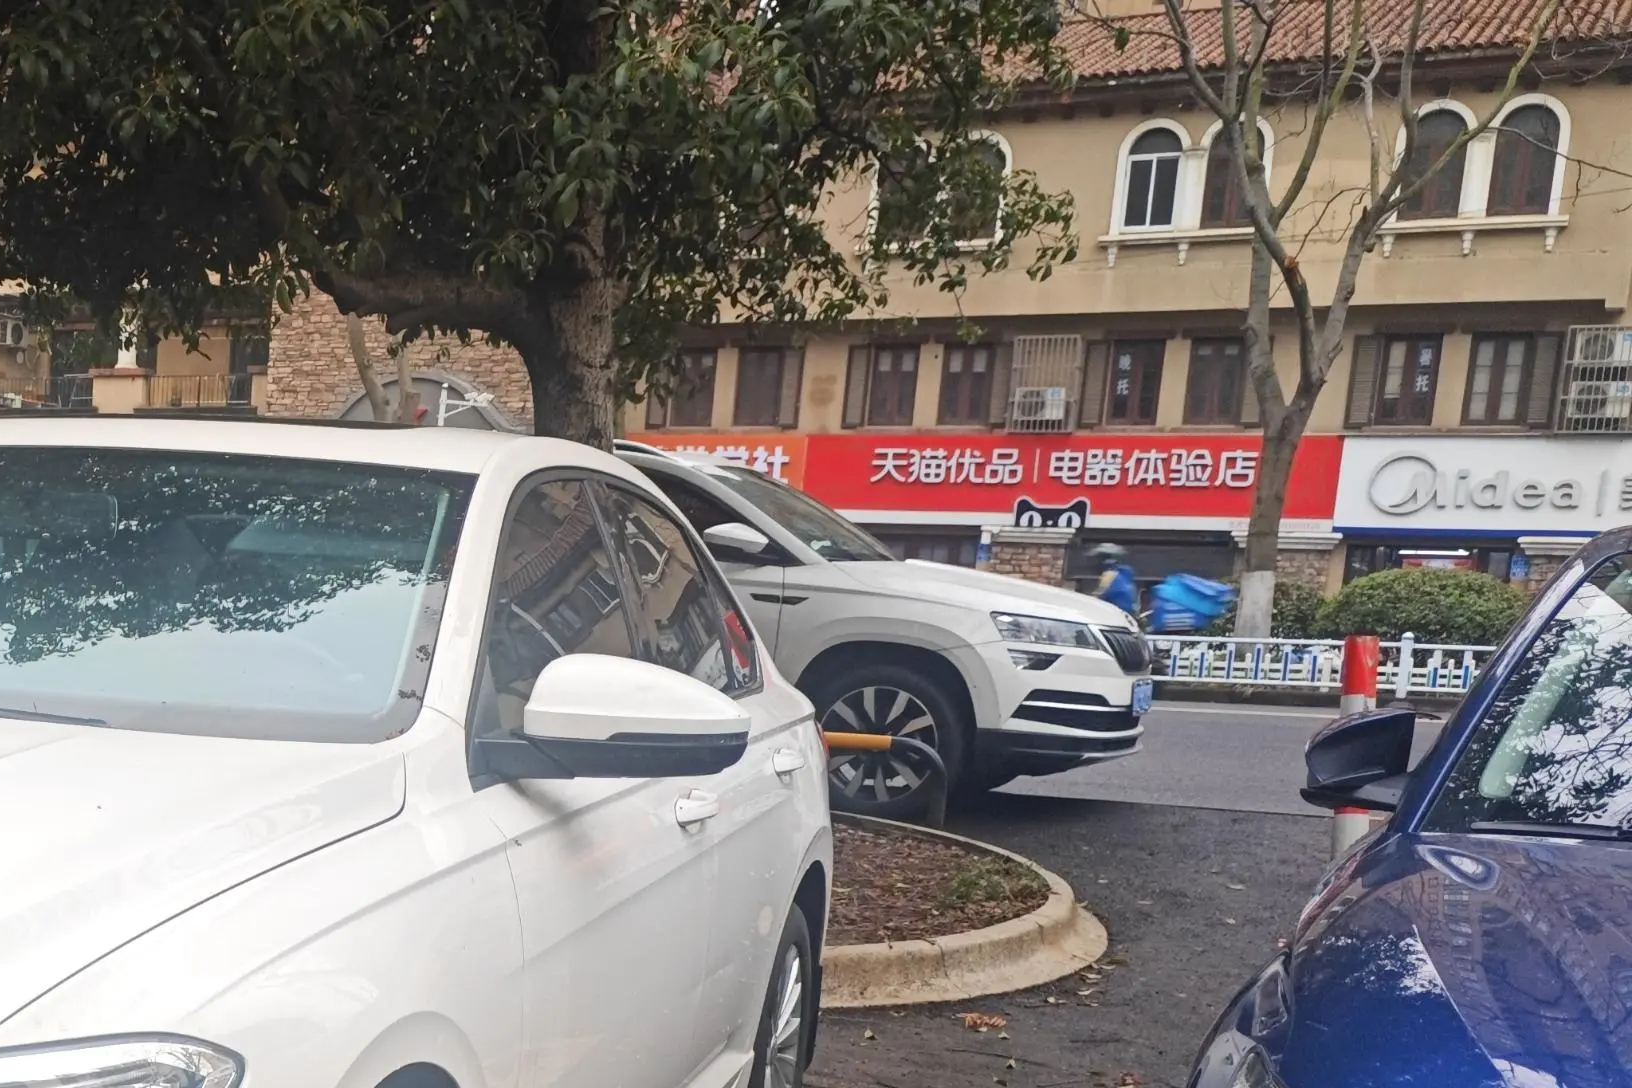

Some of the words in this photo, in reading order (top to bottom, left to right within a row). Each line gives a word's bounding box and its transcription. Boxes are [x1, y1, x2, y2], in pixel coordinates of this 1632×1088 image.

[870, 447, 1024, 485] 天猫优品
[1048, 448, 1260, 488] 电器体验店
[1369, 455, 1583, 515] Midea
